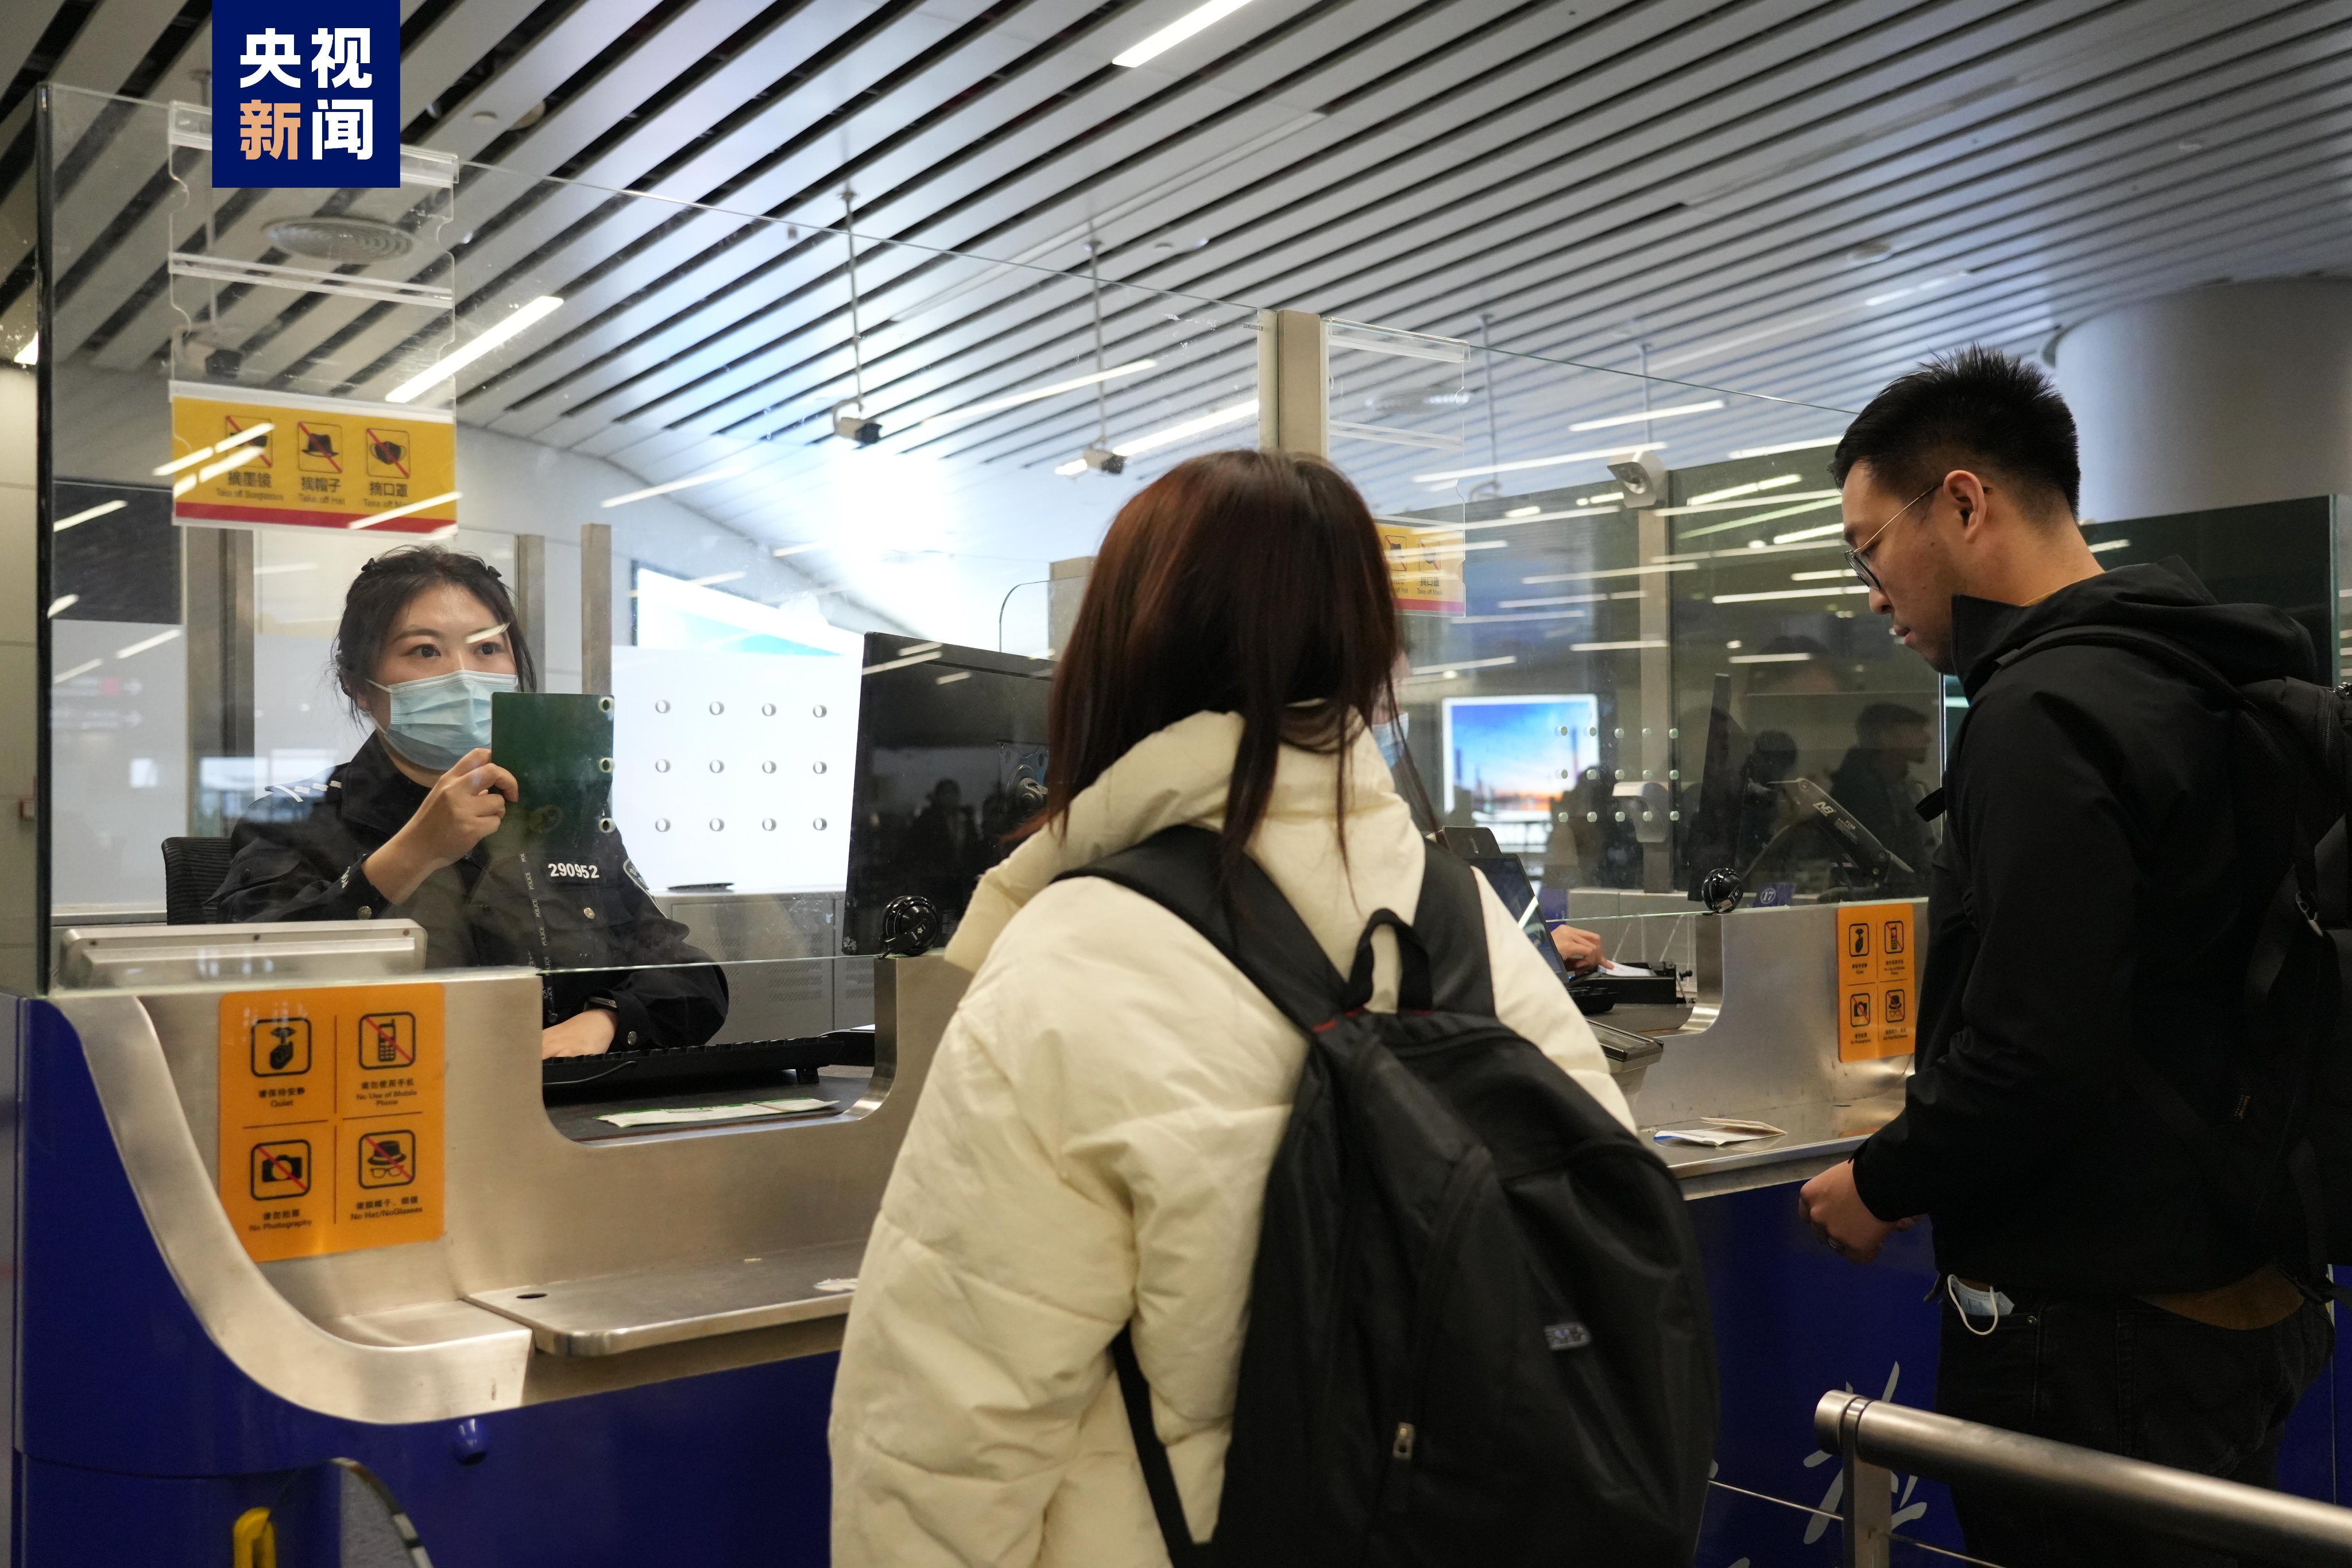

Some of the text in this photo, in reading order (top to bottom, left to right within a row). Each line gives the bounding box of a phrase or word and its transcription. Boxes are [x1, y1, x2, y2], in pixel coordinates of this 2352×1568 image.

[229, 471, 272, 487] 摘墨镜
[301, 477, 341, 493] 摘帽子
[370, 481, 408, 497] 摘口罩
[298, 493, 317, 502] Take
[363, 498, 381, 507] Take
[548, 863, 599, 879] 290952
[525, 872, 534, 890] POLICE
[532, 899, 541, 917] POLICE
[270, 1099, 293, 1108] Quiet
[263, 1219, 312, 1229] Photography
